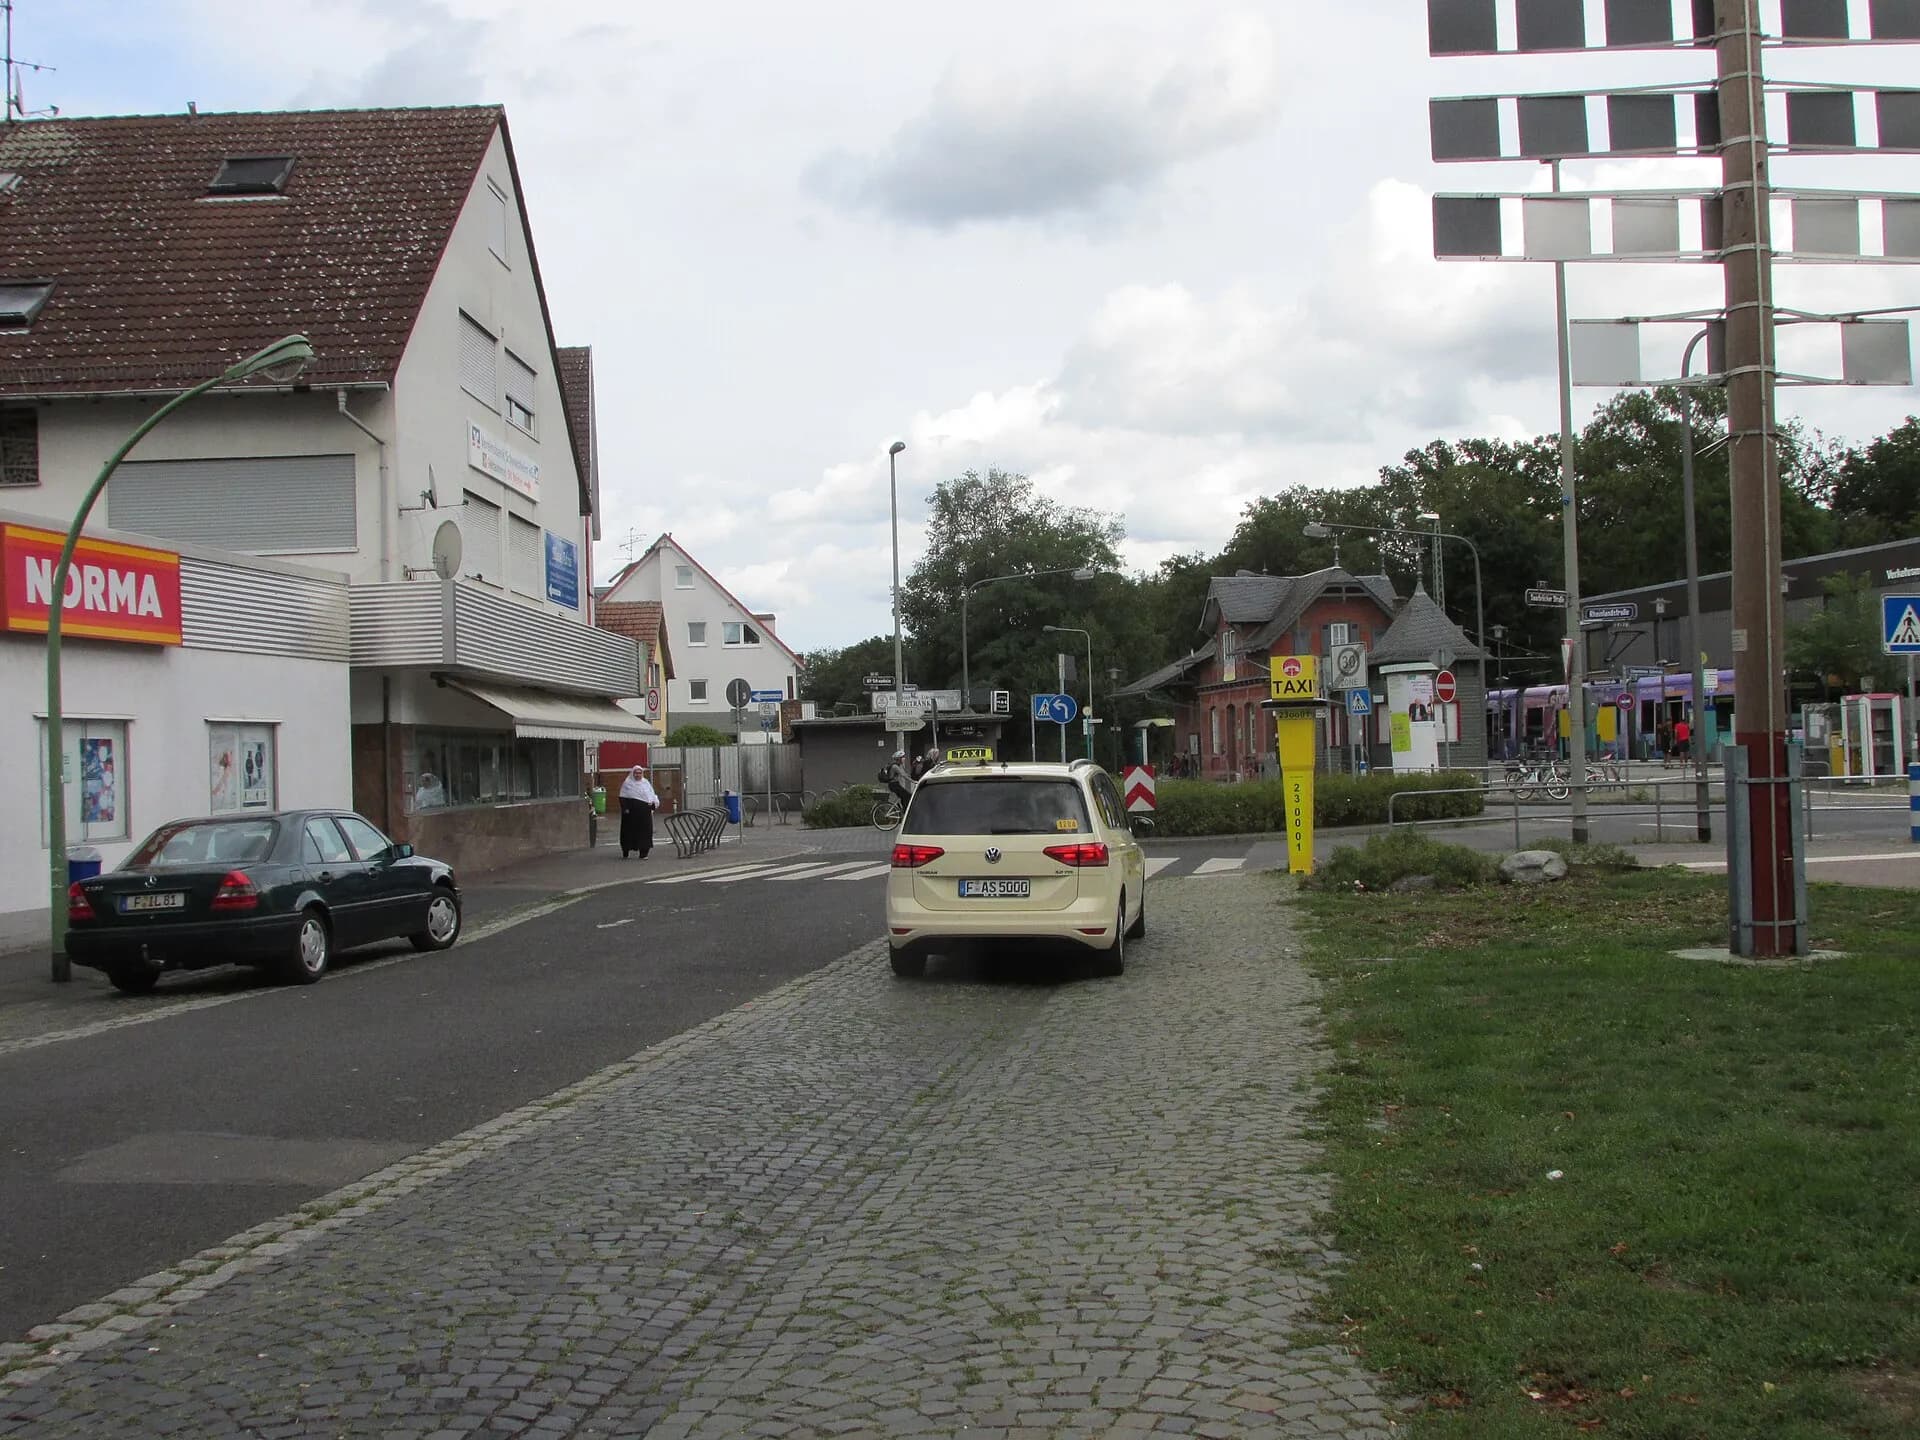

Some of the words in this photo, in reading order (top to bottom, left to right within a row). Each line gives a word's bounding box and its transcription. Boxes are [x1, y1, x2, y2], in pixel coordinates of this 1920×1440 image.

[25, 555, 163, 618] NORMA
[1342, 655, 1356, 669] 30
[1273, 680, 1313, 694] TAXI
[649, 695, 657, 706] 30
[956, 750, 982, 759] TAXI
[966, 881, 973, 893] F
[981, 881, 997, 893] AS
[999, 881, 1028, 893] 5000
